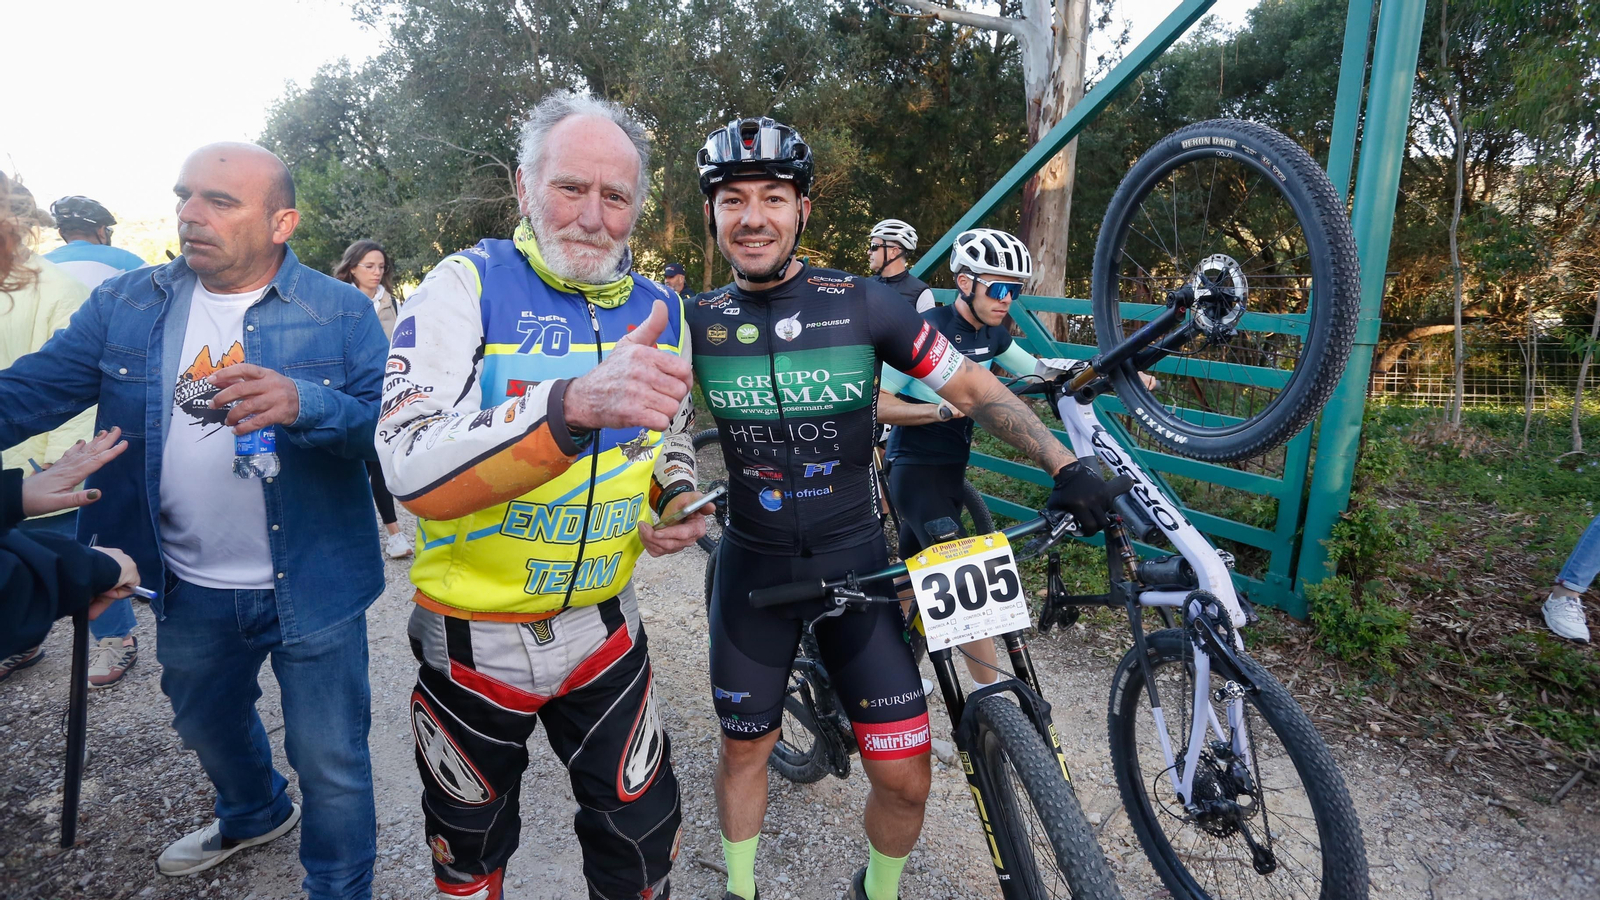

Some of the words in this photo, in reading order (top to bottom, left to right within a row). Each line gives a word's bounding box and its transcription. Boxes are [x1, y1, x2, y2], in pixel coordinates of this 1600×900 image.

[817, 286, 846, 295] FCM
[521, 310, 537, 318] EL
[805, 318, 851, 329] PROQUISUR
[515, 320, 572, 359] 70
[736, 369, 830, 389] GRUPO
[708, 379, 867, 410] SERMAN
[740, 403, 834, 416] www.gruposerman.es
[729, 420, 838, 444] HELIOS
[1135, 407, 1188, 445] MAXXIS
[736, 443, 840, 457] HOTELS
[500, 492, 645, 545] ENDURO
[523, 550, 623, 596] TEAM
[921, 554, 1020, 621] 305
[927, 622, 946, 632] CONTROL
[871, 727, 930, 751] NutriSport
